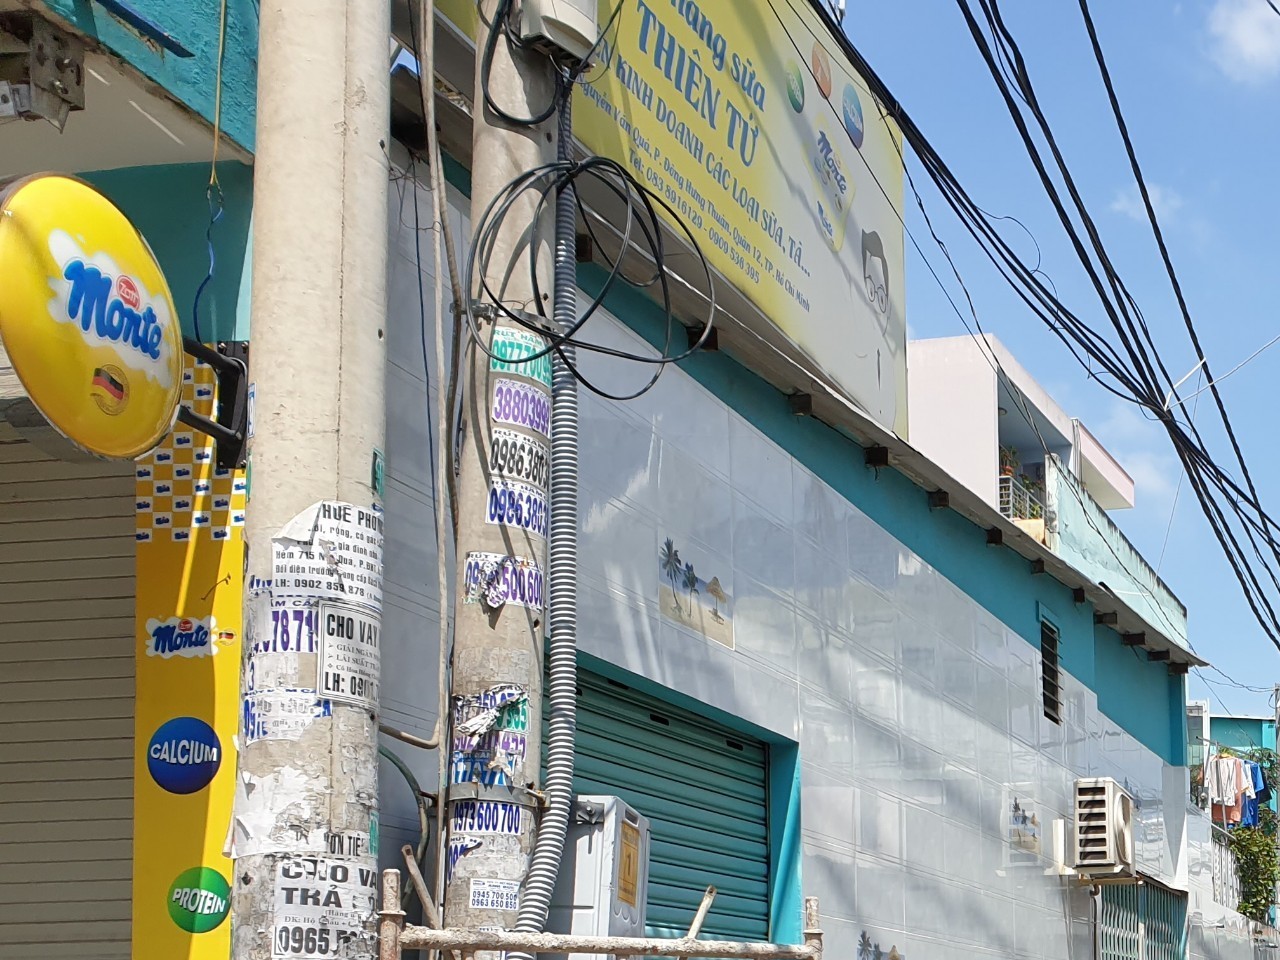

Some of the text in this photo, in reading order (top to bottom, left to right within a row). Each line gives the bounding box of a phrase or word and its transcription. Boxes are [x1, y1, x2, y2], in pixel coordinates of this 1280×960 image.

[637, 0, 721, 130] THIÊN
[616, 53, 654, 112] KINH
[656, 96, 704, 164] DOANH
[706, 152, 731, 190] CÁC
[732, 177, 760, 222] LOẠI
[64, 259, 162, 360] Monte
[274, 578, 291, 588] LH:
[294, 578, 322, 589] 0902
[326, 580, 345, 592] 859
[348, 584, 365, 598] 878
[152, 624, 208, 654] Monte
[326, 612, 378, 649] CHO VAY
[324, 671, 346, 694] LH:
[150, 739, 218, 764] CALCIUM
[171, 886, 226, 914] PROTEIN
[280, 884, 342, 909] TRẢ
[277, 925, 331, 956] 0965
